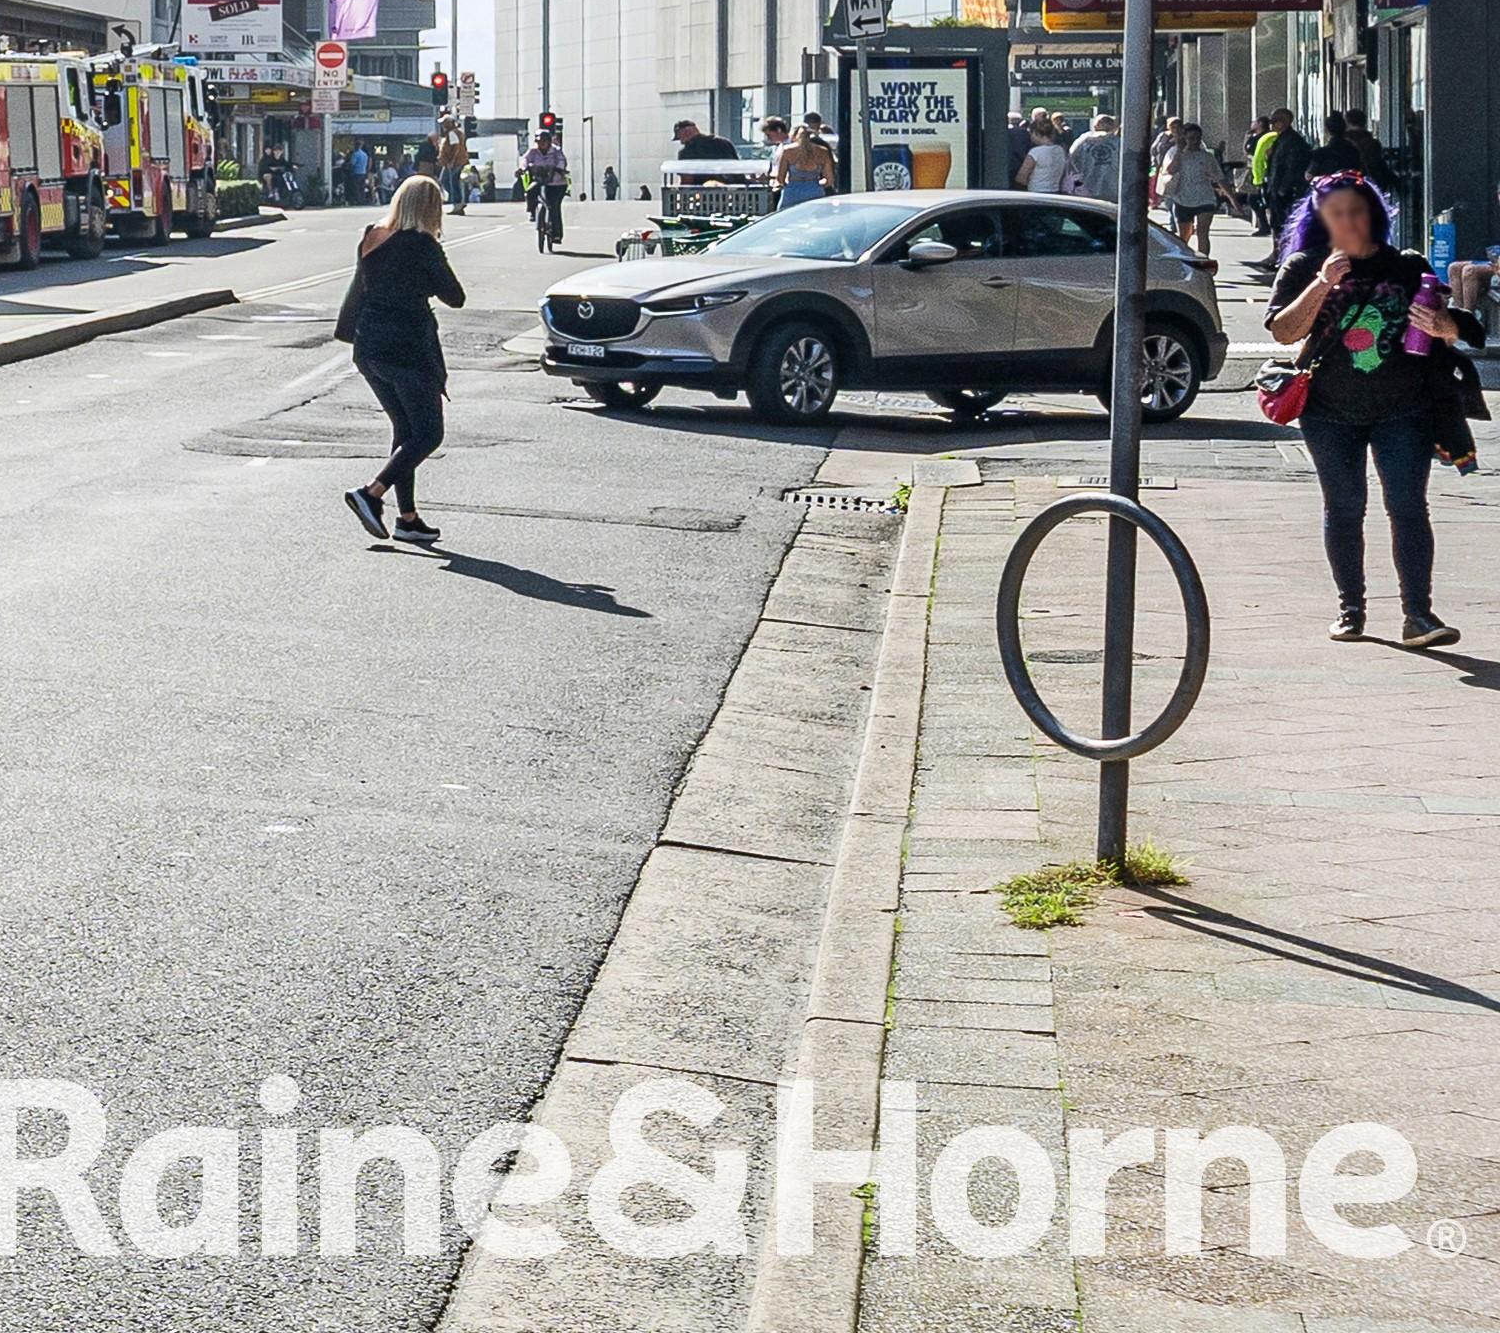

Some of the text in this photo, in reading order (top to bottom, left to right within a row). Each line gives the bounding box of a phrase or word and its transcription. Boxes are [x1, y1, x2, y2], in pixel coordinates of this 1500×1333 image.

[218, 0, 250, 17] SOLD
[1072, 58, 1093, 69] BAR
[323, 70, 338, 78] NO
[880, 81, 938, 96] WON'T
[867, 95, 955, 109] BREAK THE
[925, 109, 960, 123] CAP.
